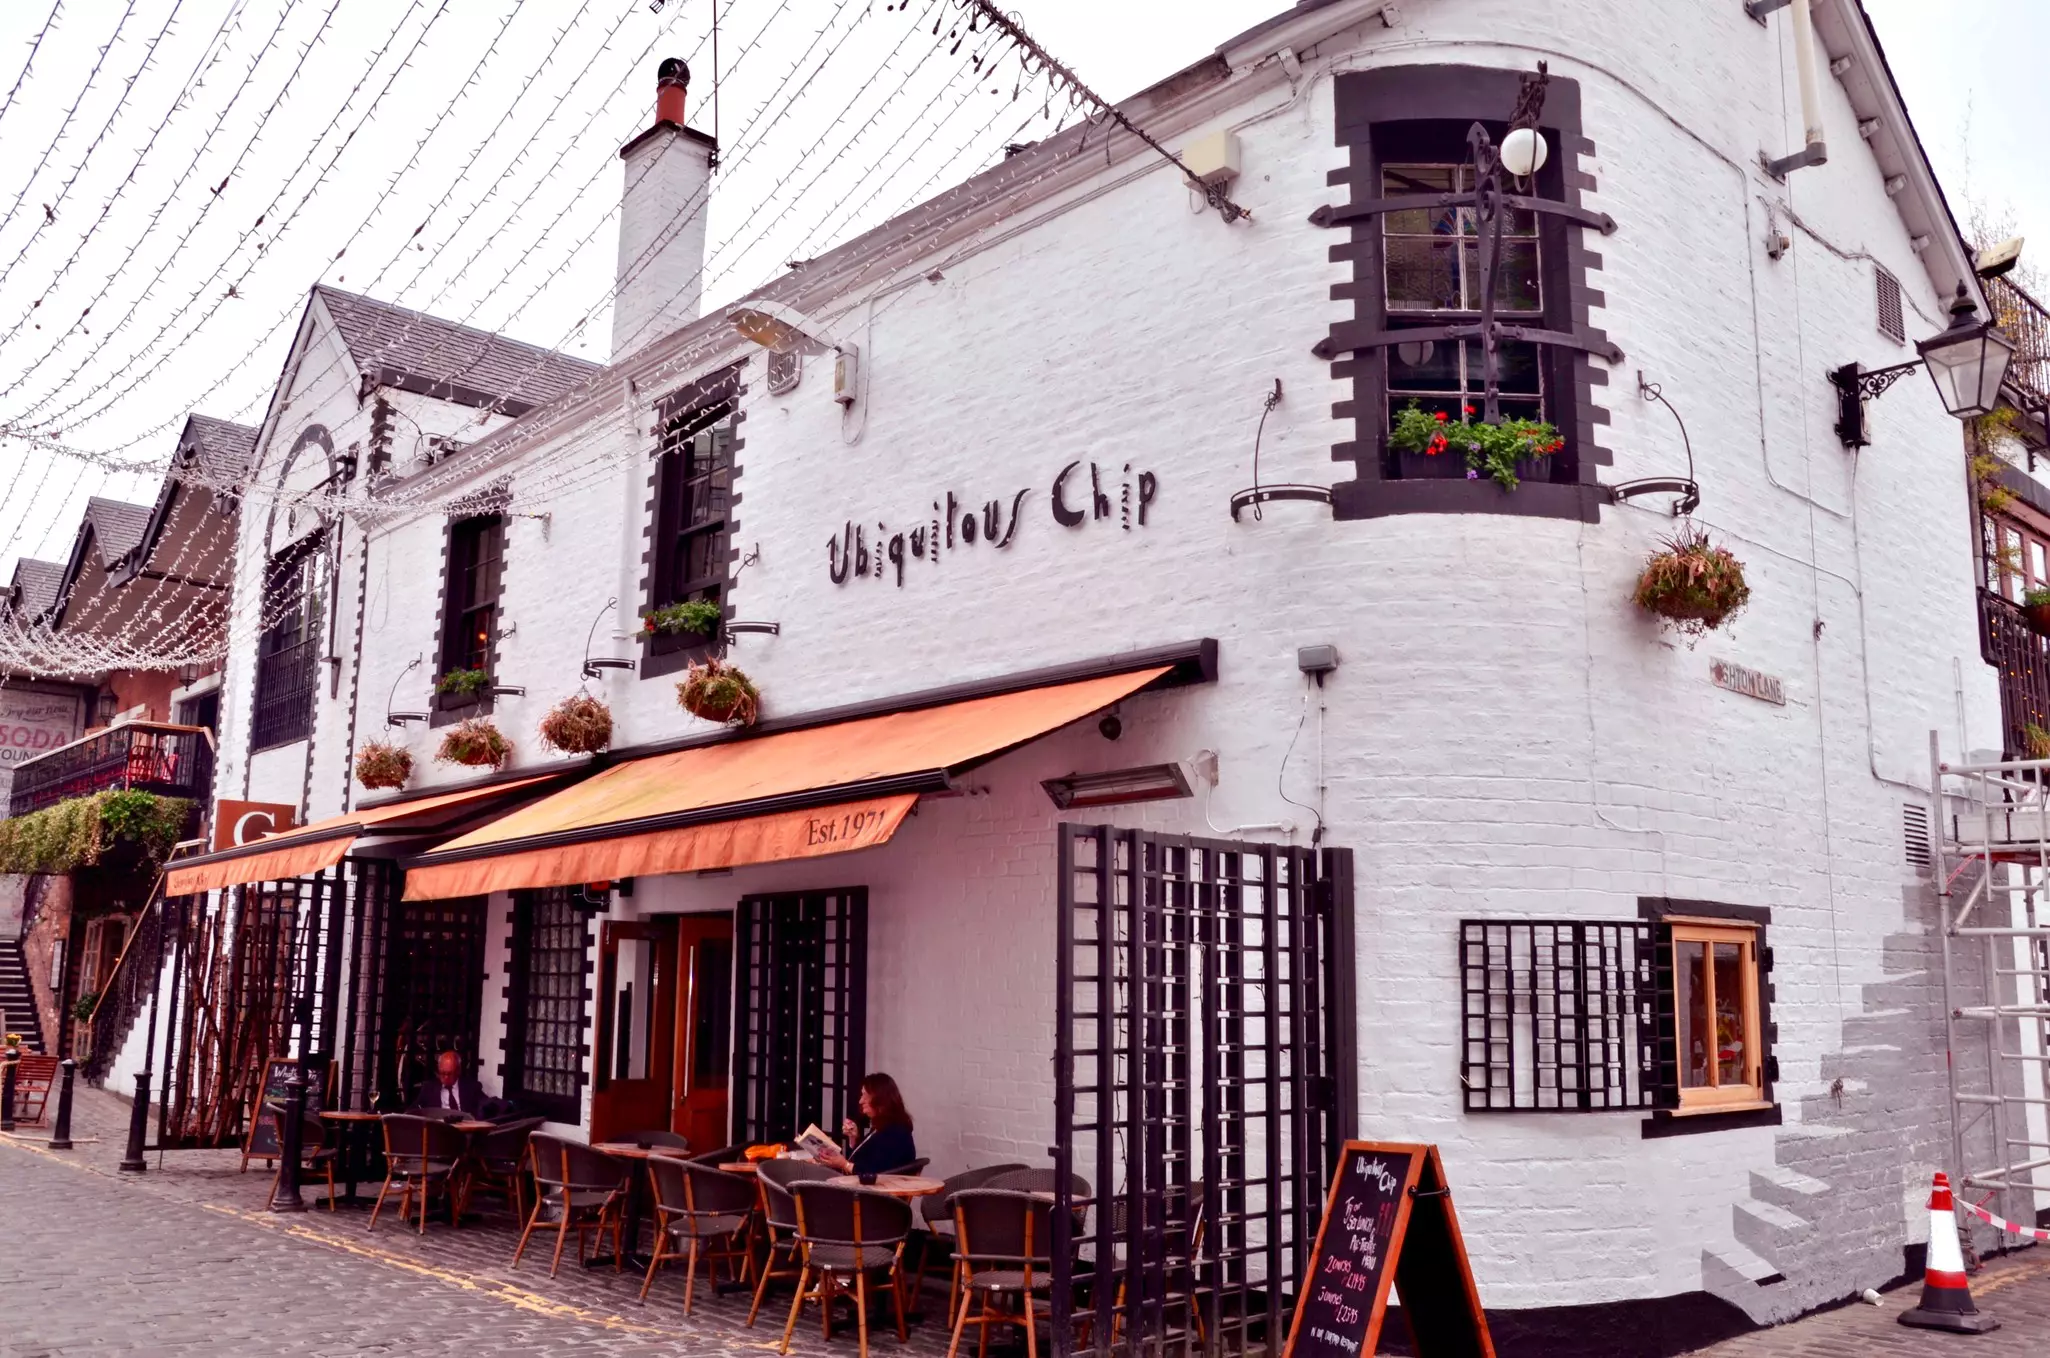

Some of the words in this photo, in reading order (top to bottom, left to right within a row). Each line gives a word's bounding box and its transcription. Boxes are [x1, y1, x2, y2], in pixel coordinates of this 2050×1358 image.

[826, 487, 1031, 588] Ubiquitous
[1051, 460, 1157, 531] Chip
[1757, 672, 1782, 700] LANE
